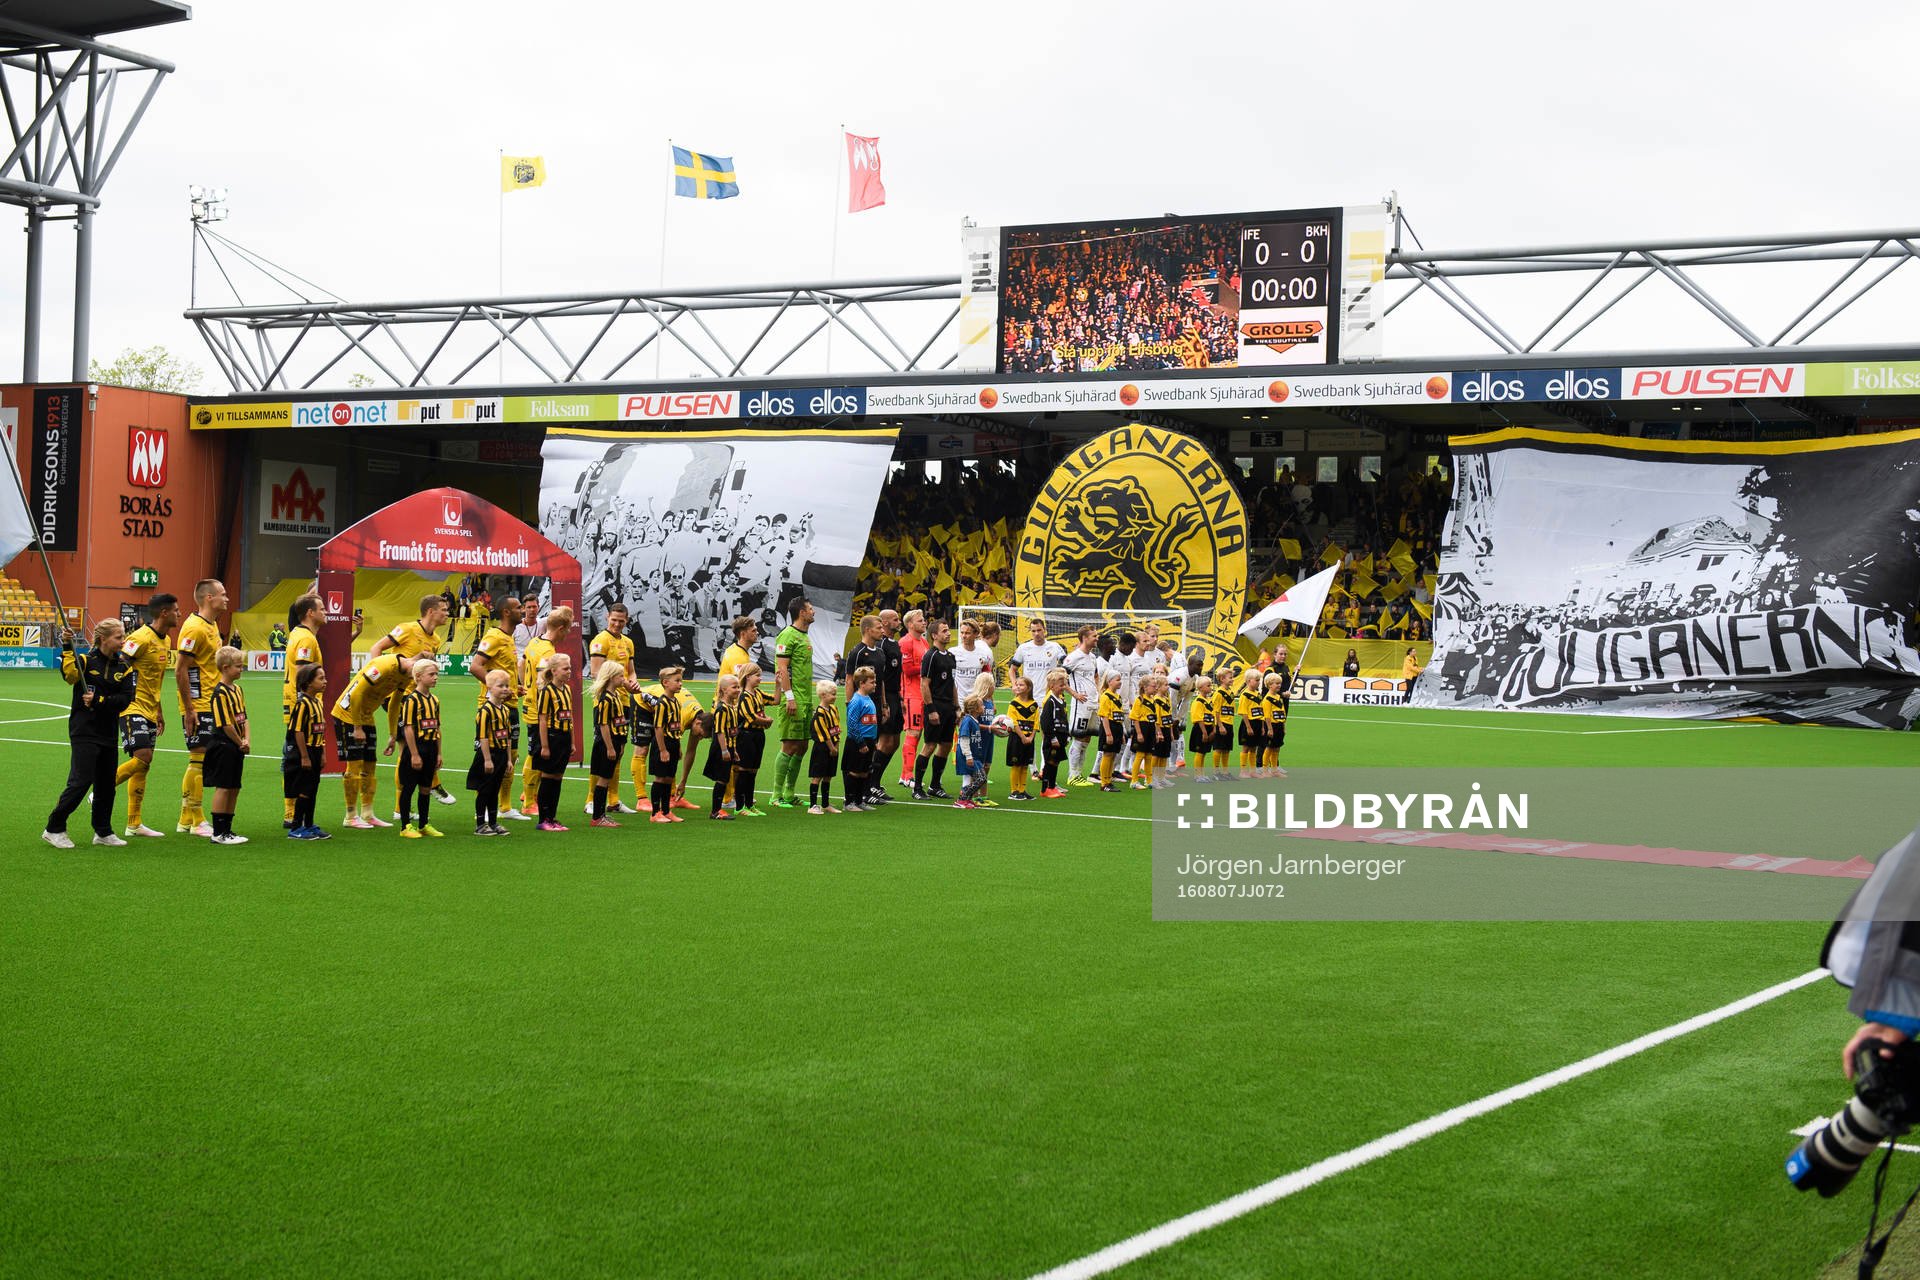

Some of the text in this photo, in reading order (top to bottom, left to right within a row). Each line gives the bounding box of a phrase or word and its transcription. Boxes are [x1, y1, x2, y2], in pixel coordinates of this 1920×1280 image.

[1244, 229, 1261, 240] IFE
[1305, 225, 1328, 237] BKH
[1255, 242, 1270, 266] 0
[1300, 239, 1315, 263] 0
[1251, 276, 1317, 302] 00:00
[1249, 323, 1314, 336] GROLLS
[1055, 344, 1076, 358] Stå
[1080, 347, 1104, 358] upp
[1108, 344, 1125, 356] för
[1294, 381, 1422, 400] Swedbank Sjuhärad
[1462, 372, 1525, 401] ellos
[1545, 370, 1610, 400] ellos
[1631, 368, 1794, 396] PULSEN
[625, 394, 733, 418] PULSEN
[747, 391, 795, 416] ellos
[809, 389, 858, 415] ellos
[868, 392, 976, 410] Swedbank Sjuhärad
[1002, 388, 1116, 407] Swedbank Sjuhärad
[1144, 385, 1265, 405] Swedbank Sjuhärad
[215, 410, 288, 422] VI TILLSAMMANS
[531, 400, 590, 418] Folksam
[271, 466, 326, 523] MAX
[1020, 428, 1244, 565] GULIGANERNA
[119, 494, 173, 518] BORÅS
[122, 518, 165, 539] STAD
[434, 527, 473, 537] SVENSKA SPEL
[379, 540, 529, 568] Framåt för svensk fotboll!
